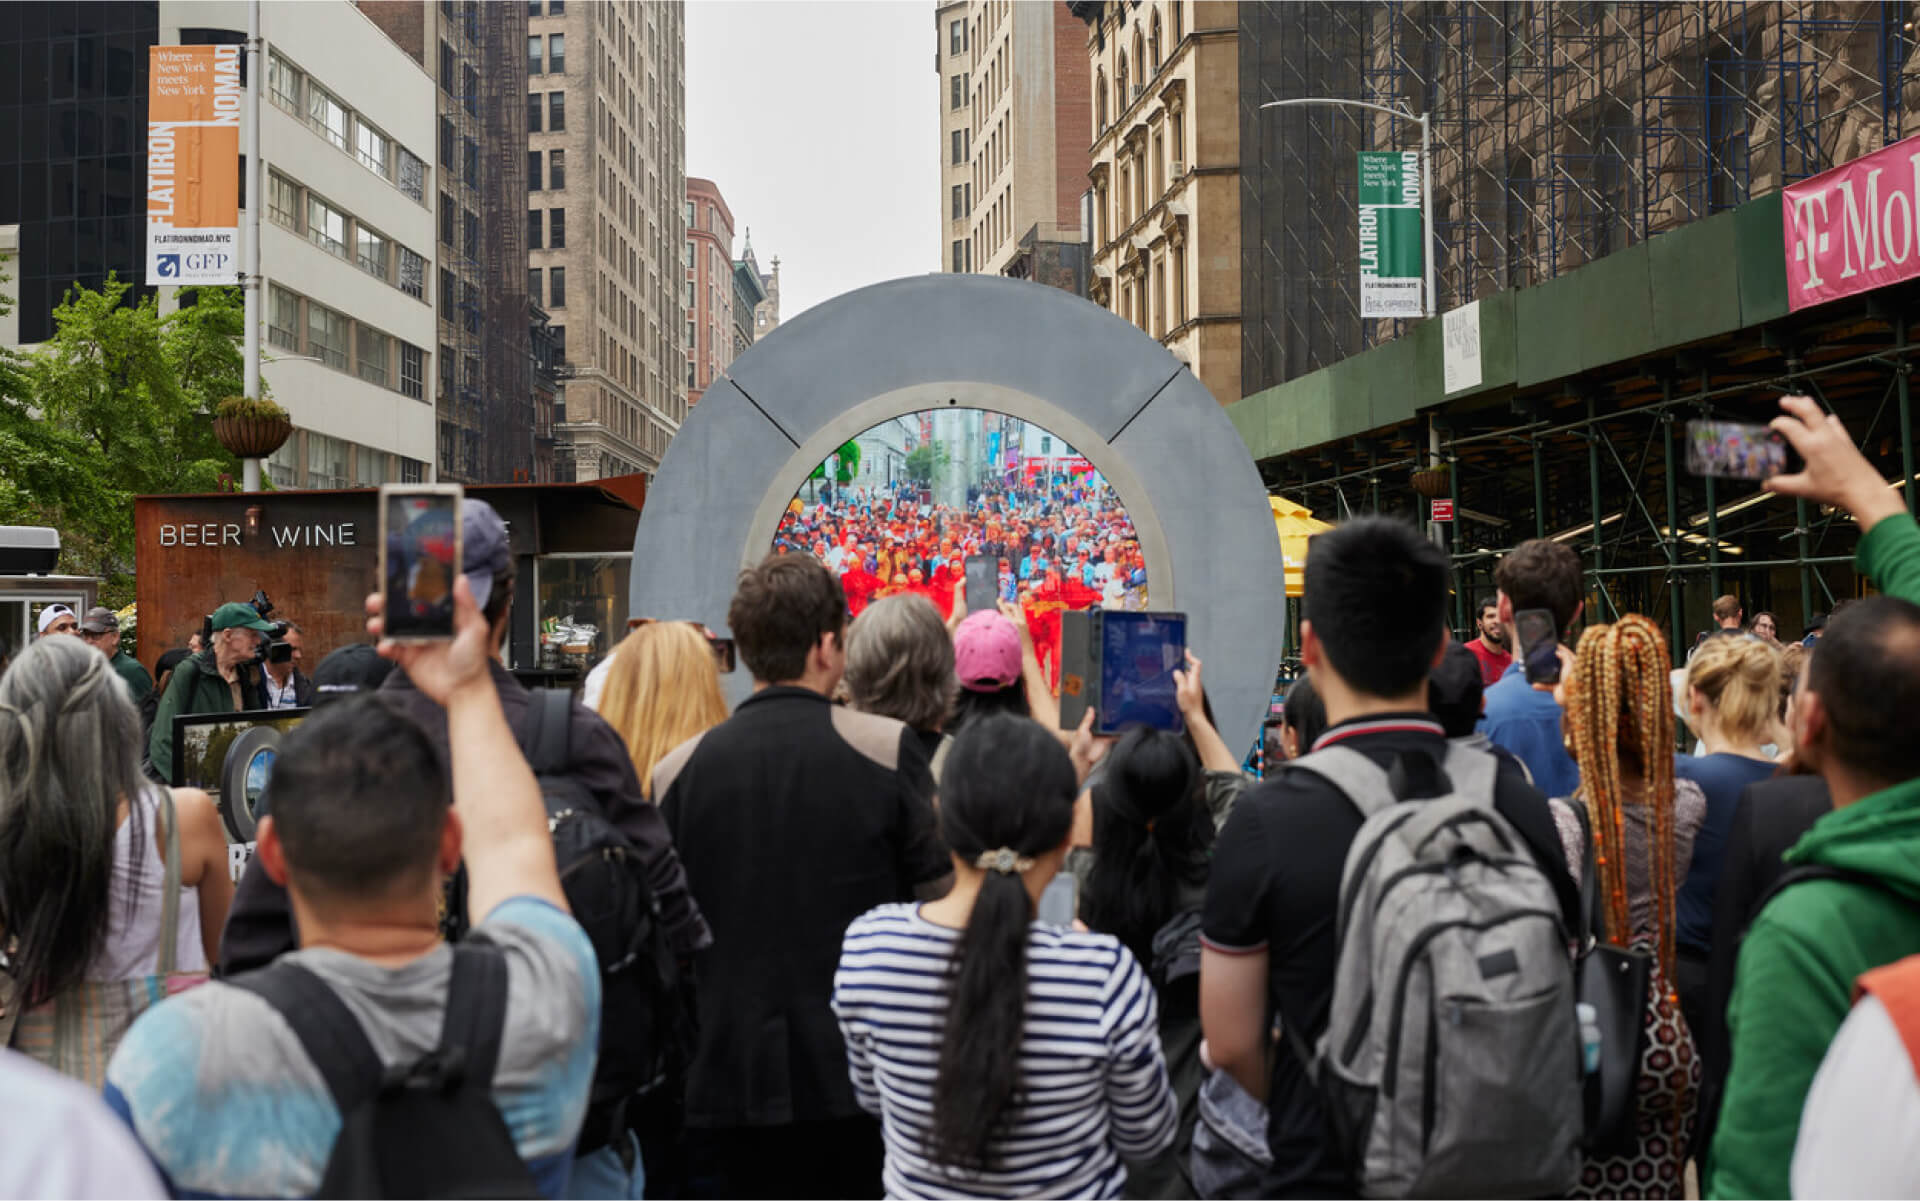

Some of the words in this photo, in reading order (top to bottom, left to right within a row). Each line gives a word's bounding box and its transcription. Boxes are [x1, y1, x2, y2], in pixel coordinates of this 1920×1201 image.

[158, 51, 193, 62] Where
[158, 63, 180, 73] New
[183, 62, 206, 73] York
[158, 75, 189, 85] meets
[214, 45, 240, 125] NOMAD
[158, 86, 180, 96] New
[183, 85, 206, 96] York
[1363, 155, 1387, 163] Where
[148, 125, 175, 228] FLATIRON
[1402, 152, 1420, 206] NOMAD
[1381, 179, 1397, 187] York
[154, 234, 231, 244] FLATIRONNOMAD.NYC
[1360, 207, 1378, 278] FLATIRON
[186, 253, 229, 270] GFP
[159, 523, 242, 547] BEER
[271, 522, 356, 548] WINE
